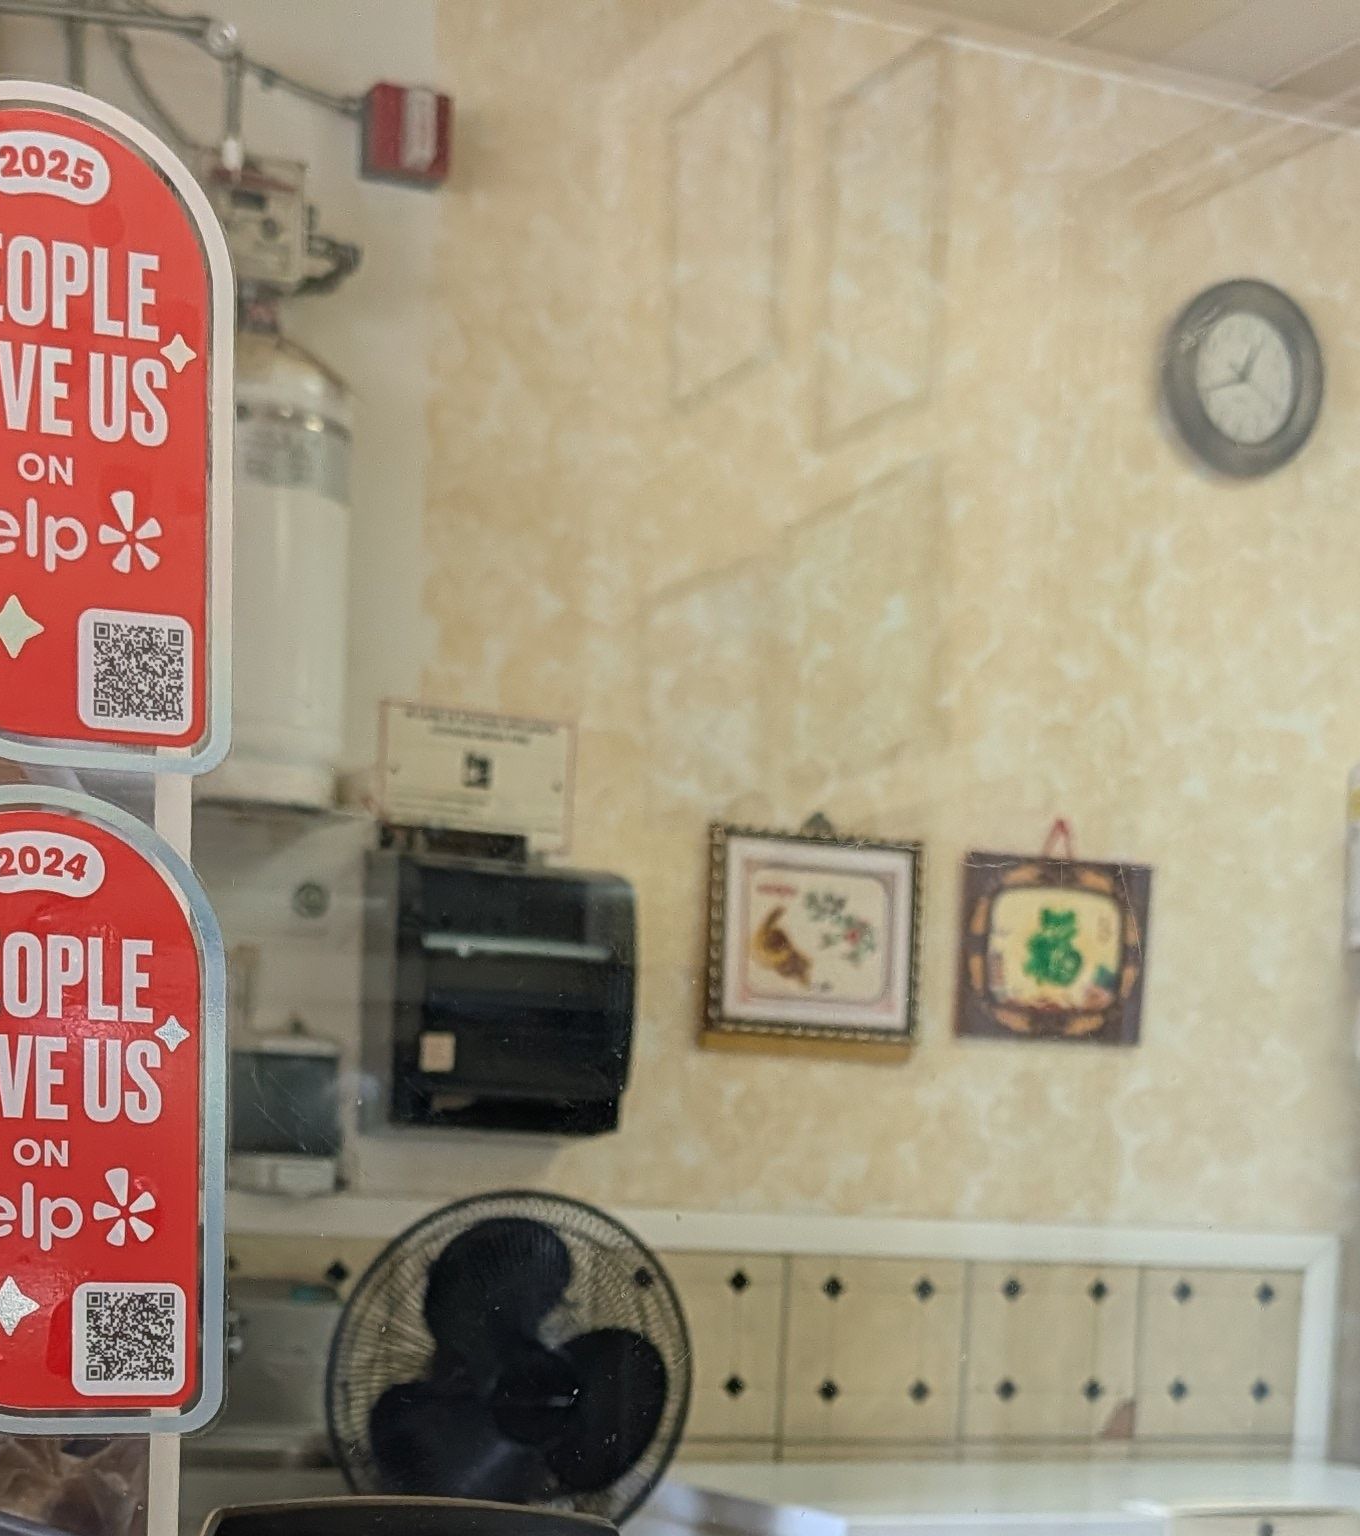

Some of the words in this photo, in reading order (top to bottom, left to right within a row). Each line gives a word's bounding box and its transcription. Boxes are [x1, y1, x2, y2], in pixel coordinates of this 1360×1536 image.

[89, 351, 169, 448] US
[17, 452, 74, 487] ON
[83, 1037, 162, 1124] US
[13, 1138, 70, 1167] ON
